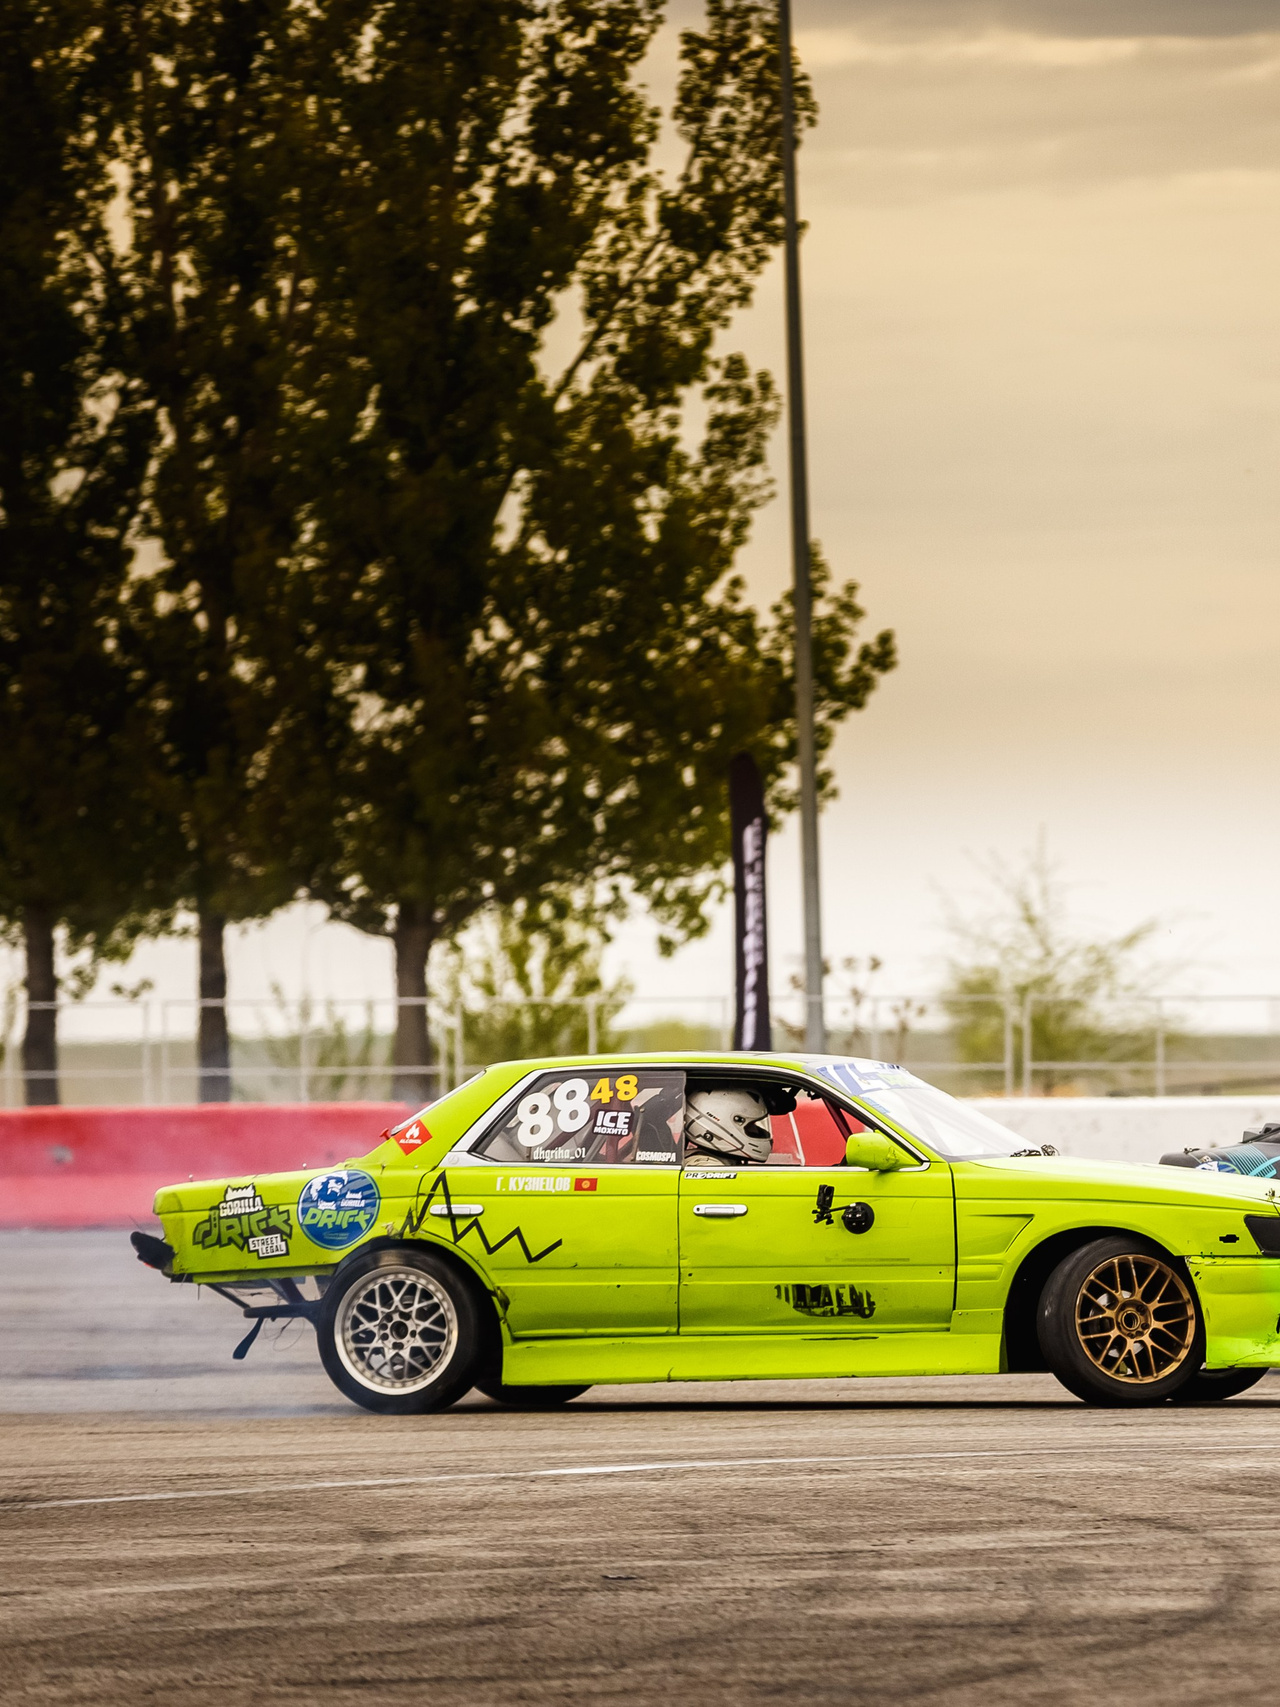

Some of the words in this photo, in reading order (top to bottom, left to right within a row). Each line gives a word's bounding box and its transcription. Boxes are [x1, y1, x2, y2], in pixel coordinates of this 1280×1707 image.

[590, 1075, 638, 1104] 48
[517, 1078, 591, 1147] 88
[596, 1111, 631, 1128] ICE
[636, 1151, 676, 1162] COSMOSPA
[509, 1177, 571, 1193] КУЗНЕЦОВ
[219, 1198, 264, 1217] GORILLA
[251, 1236, 279, 1249] STREET
[261, 1245, 284, 1256] LEGAL
